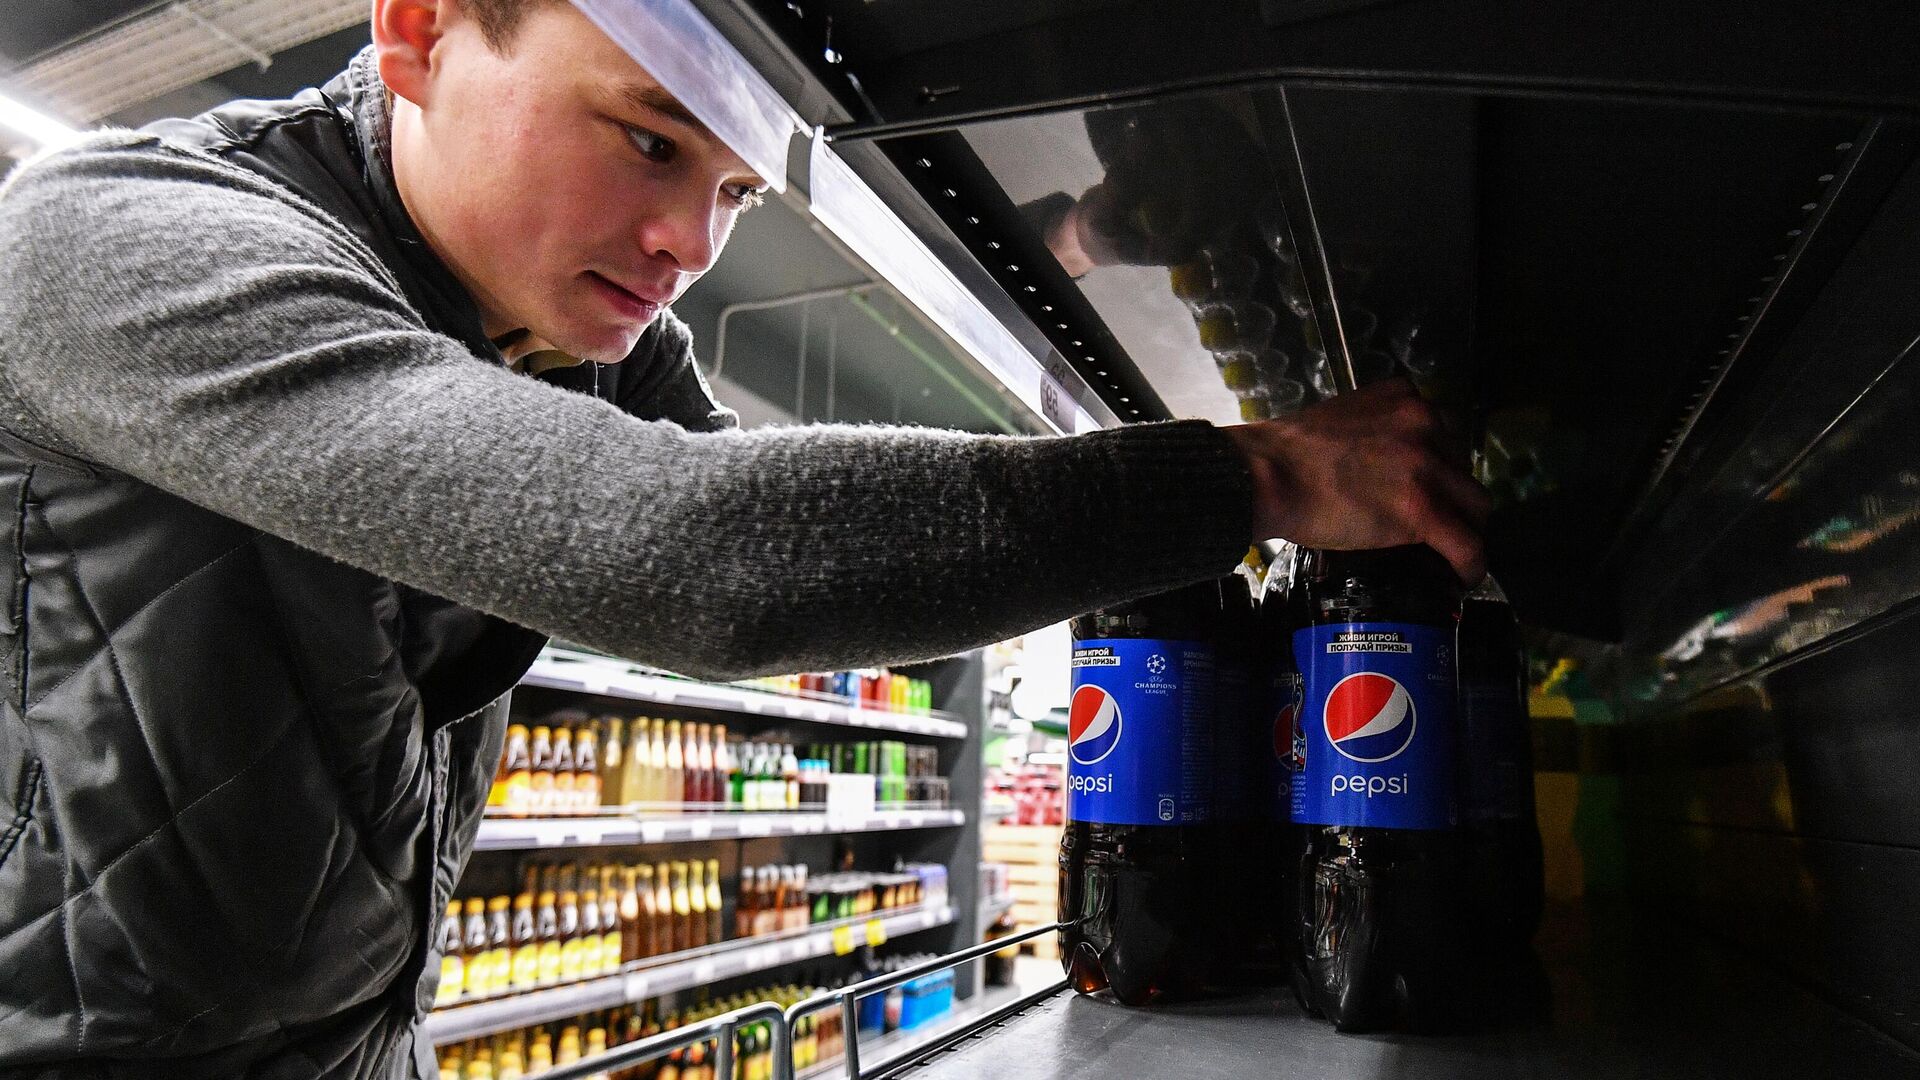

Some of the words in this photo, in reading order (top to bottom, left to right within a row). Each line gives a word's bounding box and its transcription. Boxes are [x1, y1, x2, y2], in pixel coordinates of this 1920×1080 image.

[1339, 633, 1365, 642] ЖИВИ
[1367, 633, 1399, 642] ИГРОЙ
[1331, 642, 1373, 652] ПОЛУЧАЙ
[1376, 644, 1408, 652] ПРИЗЫ
[1087, 648, 1110, 656] ИГРОЙ
[1134, 682, 1177, 690] CHAMPIONS
[1068, 773, 1113, 796] pepsi
[1331, 773, 1408, 798] pepsi
